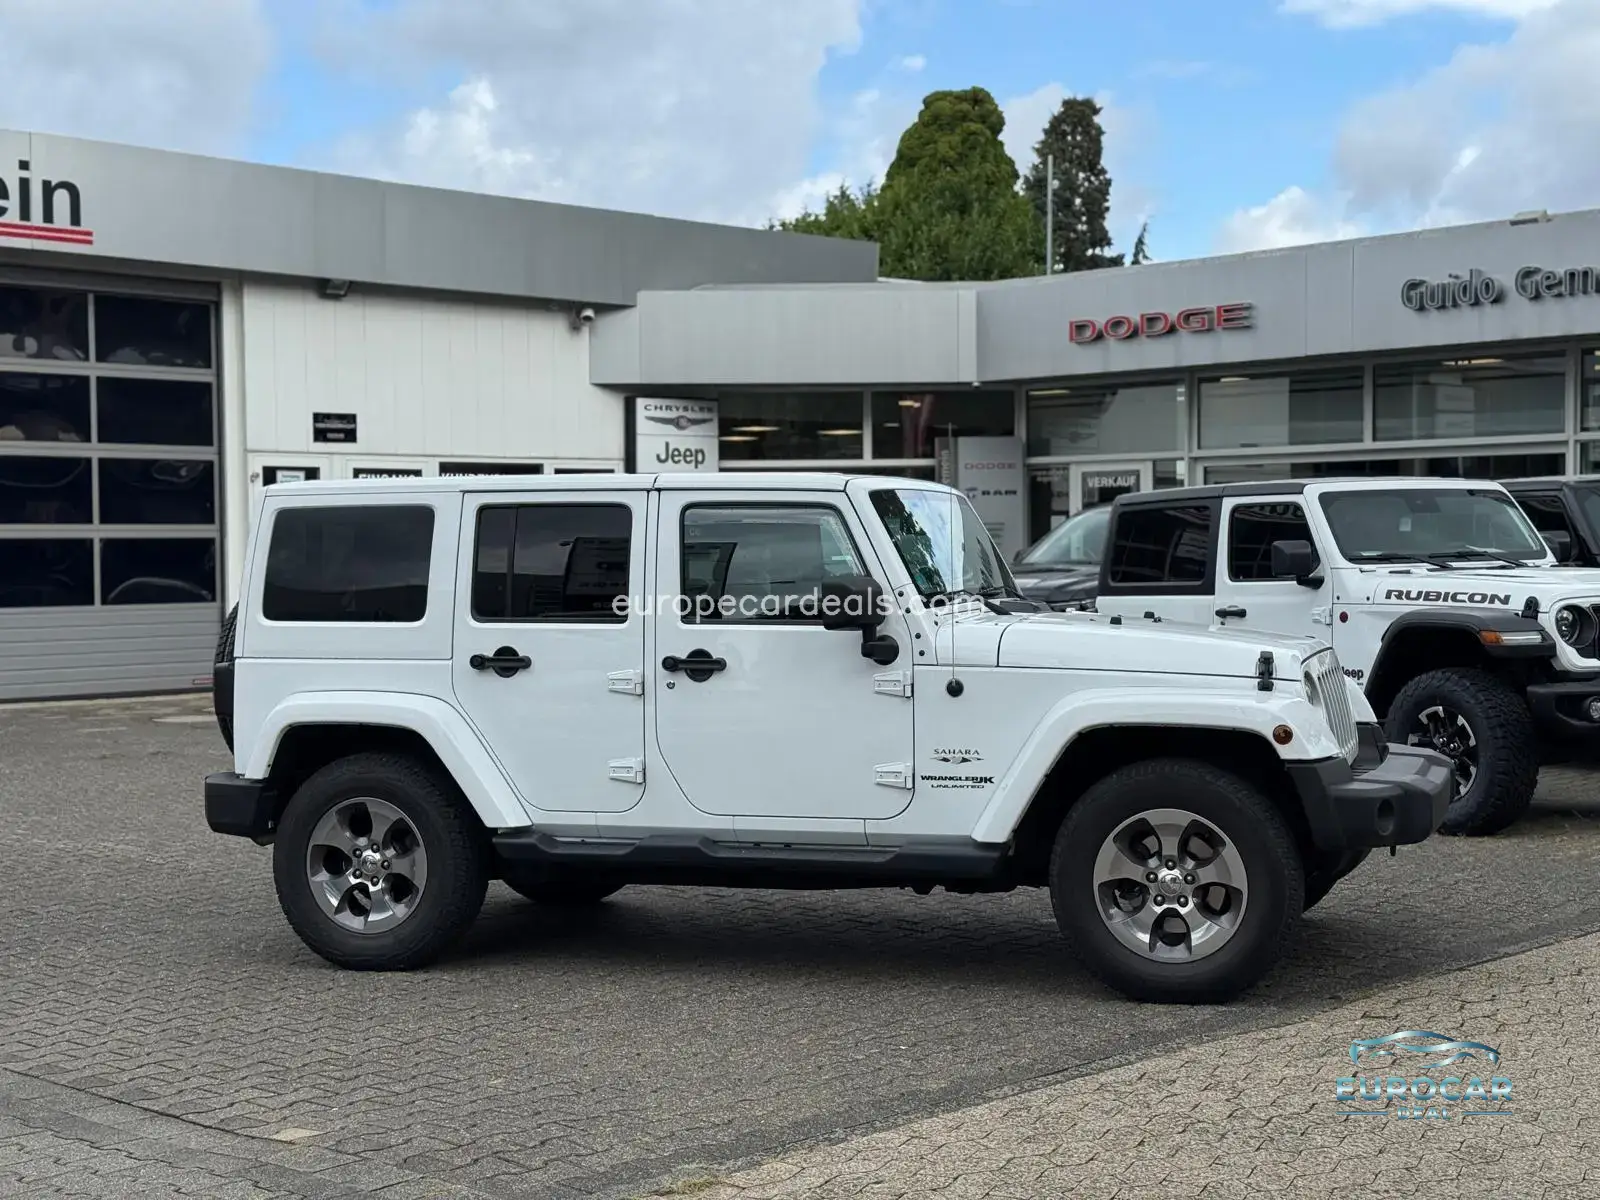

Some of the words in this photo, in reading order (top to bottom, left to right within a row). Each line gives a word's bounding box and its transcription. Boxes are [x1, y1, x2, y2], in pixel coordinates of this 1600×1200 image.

[0, 159, 82, 227] in
[1401, 268, 1498, 311] Guido
[1069, 302, 1252, 343] DODGE
[643, 403, 714, 413] CHRYSLER
[656, 441, 706, 469] Jeep
[964, 462, 1017, 470] DODGE
[1087, 475, 1137, 488] VERKAUF
[1384, 589, 1512, 606] RUBICON
